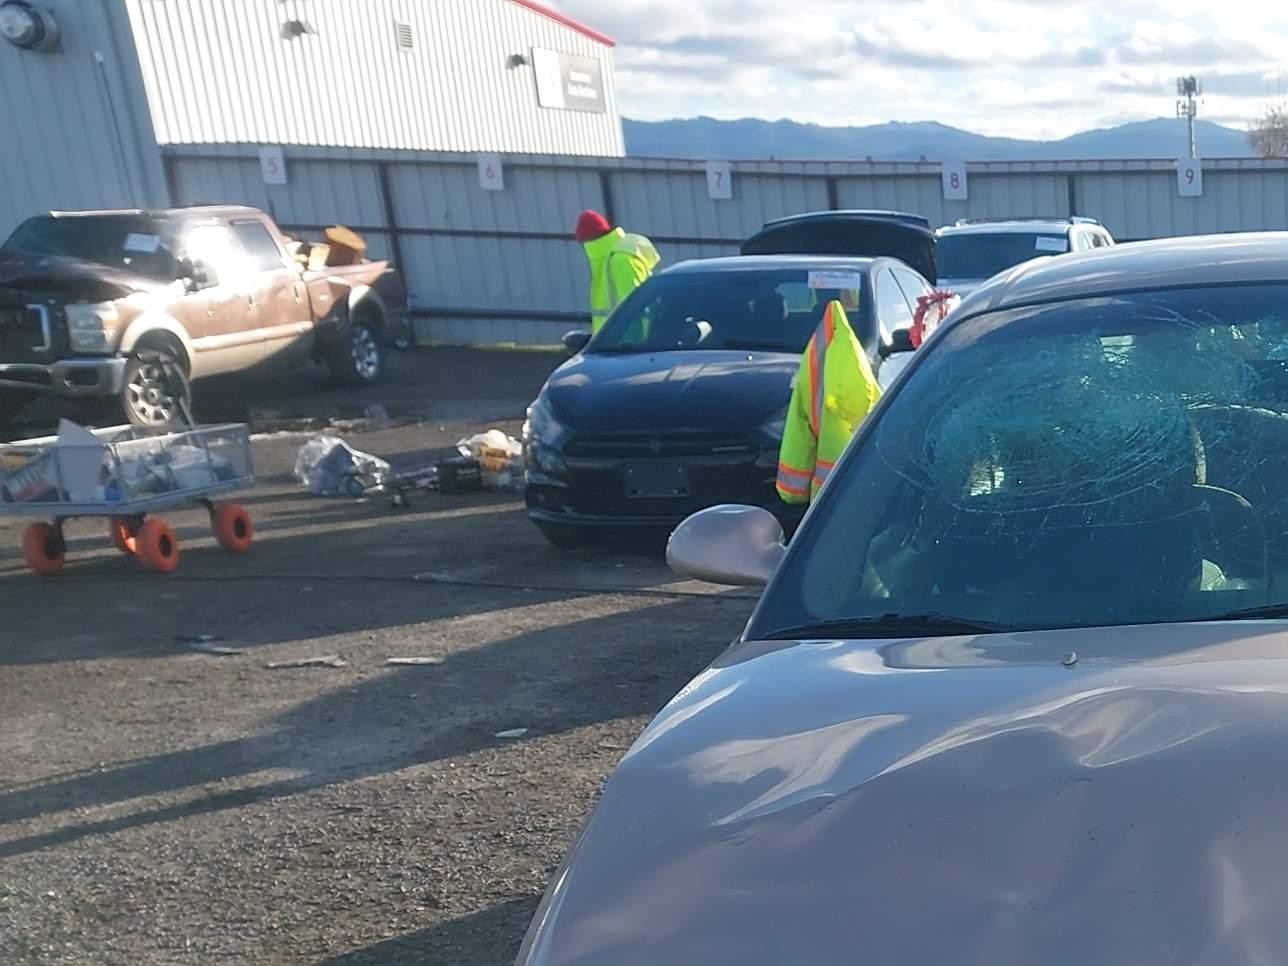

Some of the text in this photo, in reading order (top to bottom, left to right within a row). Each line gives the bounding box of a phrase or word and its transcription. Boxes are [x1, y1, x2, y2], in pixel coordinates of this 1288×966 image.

[267, 156, 277, 174] 5
[485, 162, 495, 180] 6
[714, 171, 723, 188] 7
[950, 172, 960, 189] 8
[1184, 168, 1195, 185] 9
